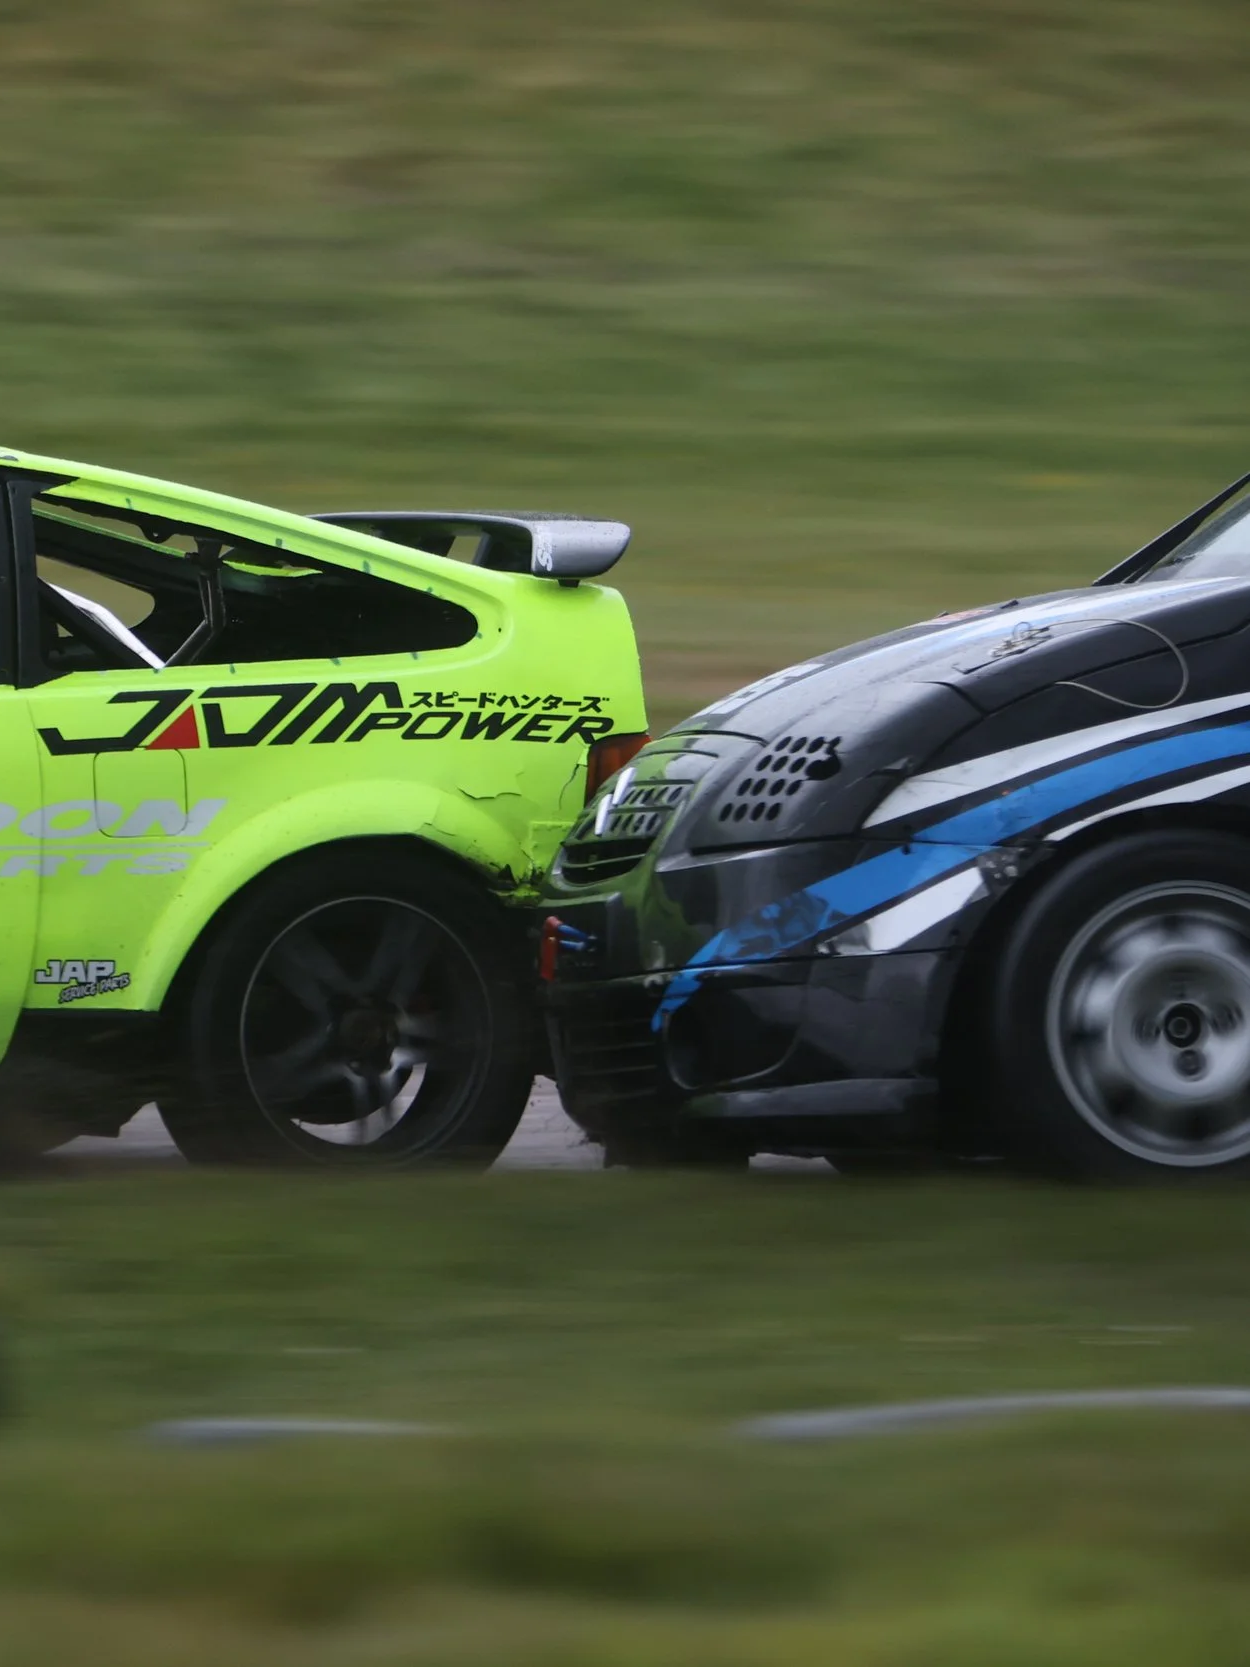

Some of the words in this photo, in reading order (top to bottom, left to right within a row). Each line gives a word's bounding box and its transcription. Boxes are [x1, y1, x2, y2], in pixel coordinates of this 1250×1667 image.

[409, 691, 610, 713] スピードハンターズ
[344, 711, 615, 745] POWER
[35, 959, 116, 984] JAP
